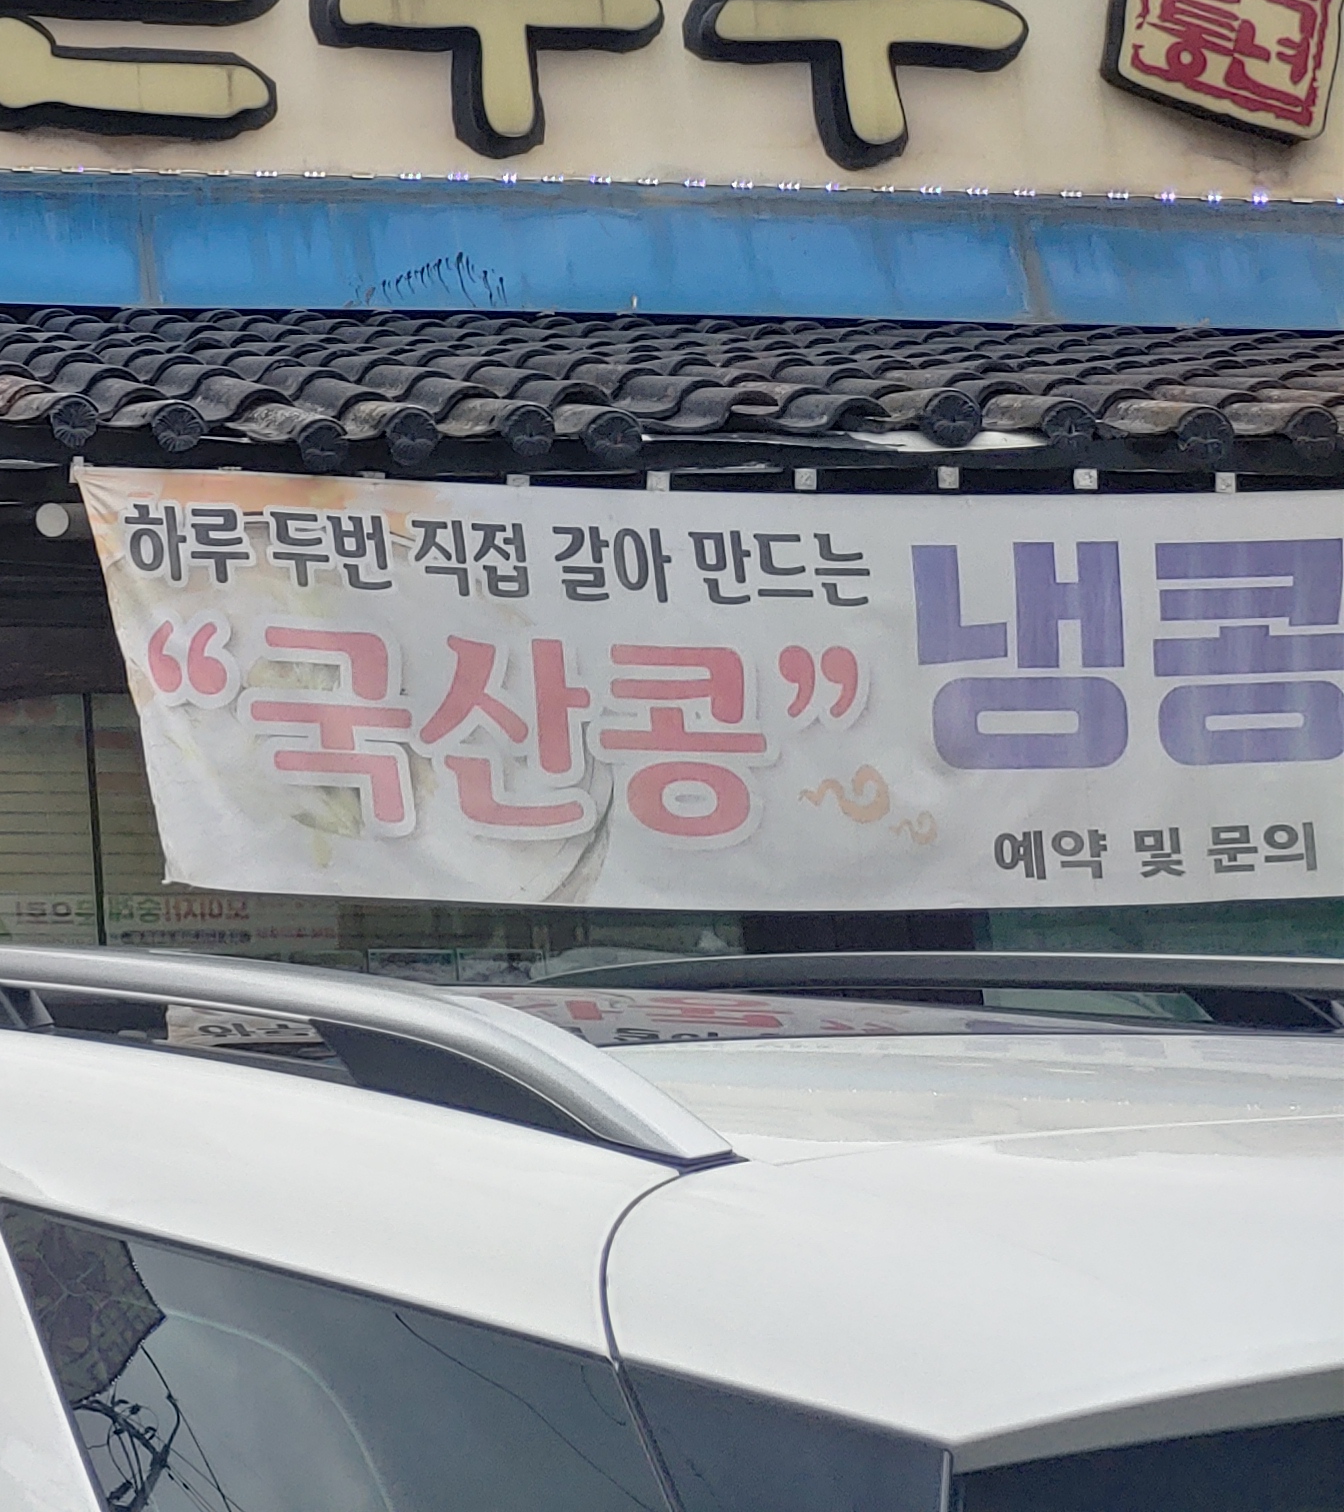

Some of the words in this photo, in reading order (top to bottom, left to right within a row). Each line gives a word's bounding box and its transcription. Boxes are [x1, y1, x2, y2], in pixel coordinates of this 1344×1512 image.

[124, 502, 251, 585] 하루
[265, 511, 394, 592] 두번
[413, 518, 531, 599] 직접
[552, 523, 673, 604] 갈아
[690, 530, 872, 607] 만드는
[910, 538, 1344, 771] 냉콩
[994, 829, 1108, 880] 예약
[1133, 826, 1186, 879] 및
[1206, 821, 1318, 874] 문의
